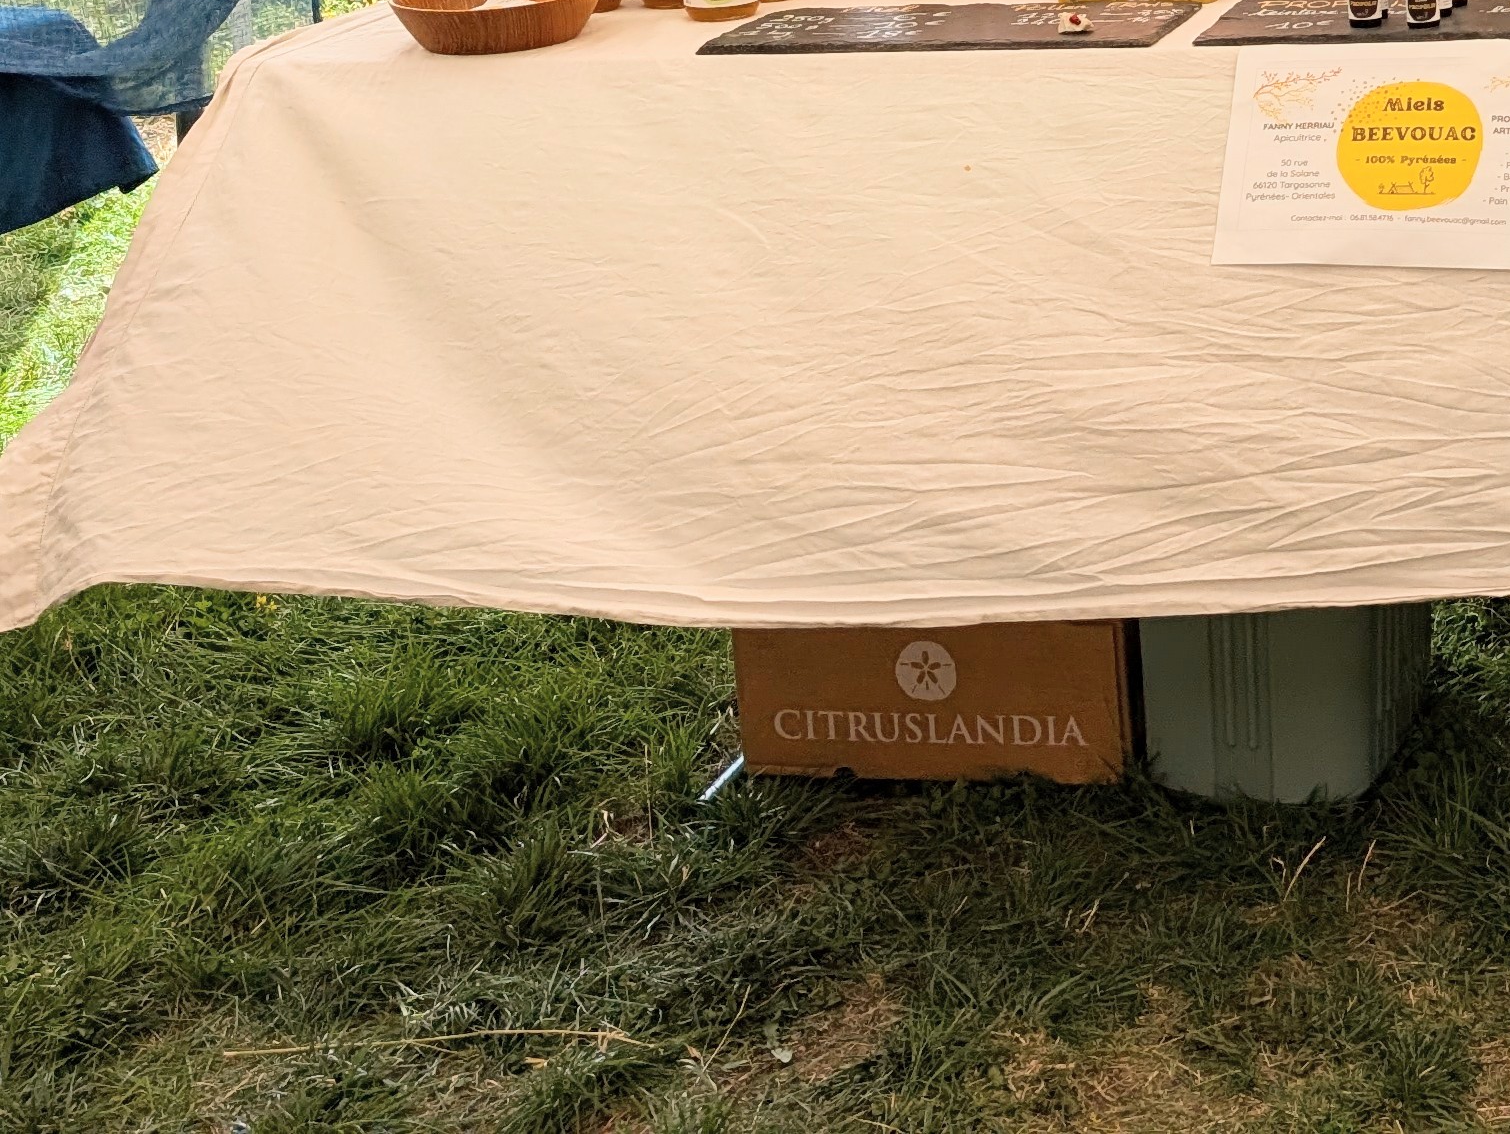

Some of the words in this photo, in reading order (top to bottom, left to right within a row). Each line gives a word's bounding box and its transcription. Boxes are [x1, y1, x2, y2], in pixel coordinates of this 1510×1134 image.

[1382, 97, 1444, 111] Miels
[1274, 134, 1321, 143] Apicultrice
[1352, 126, 1476, 141] BEEVOUAC
[1365, 155, 1395, 164] 100%
[1400, 155, 1457, 166] Pyrénées
[1280, 181, 1331, 190] Targasonne
[1489, 197, 1507, 205] Pain
[773, 708, 1090, 747] CITRUSLANDIA
